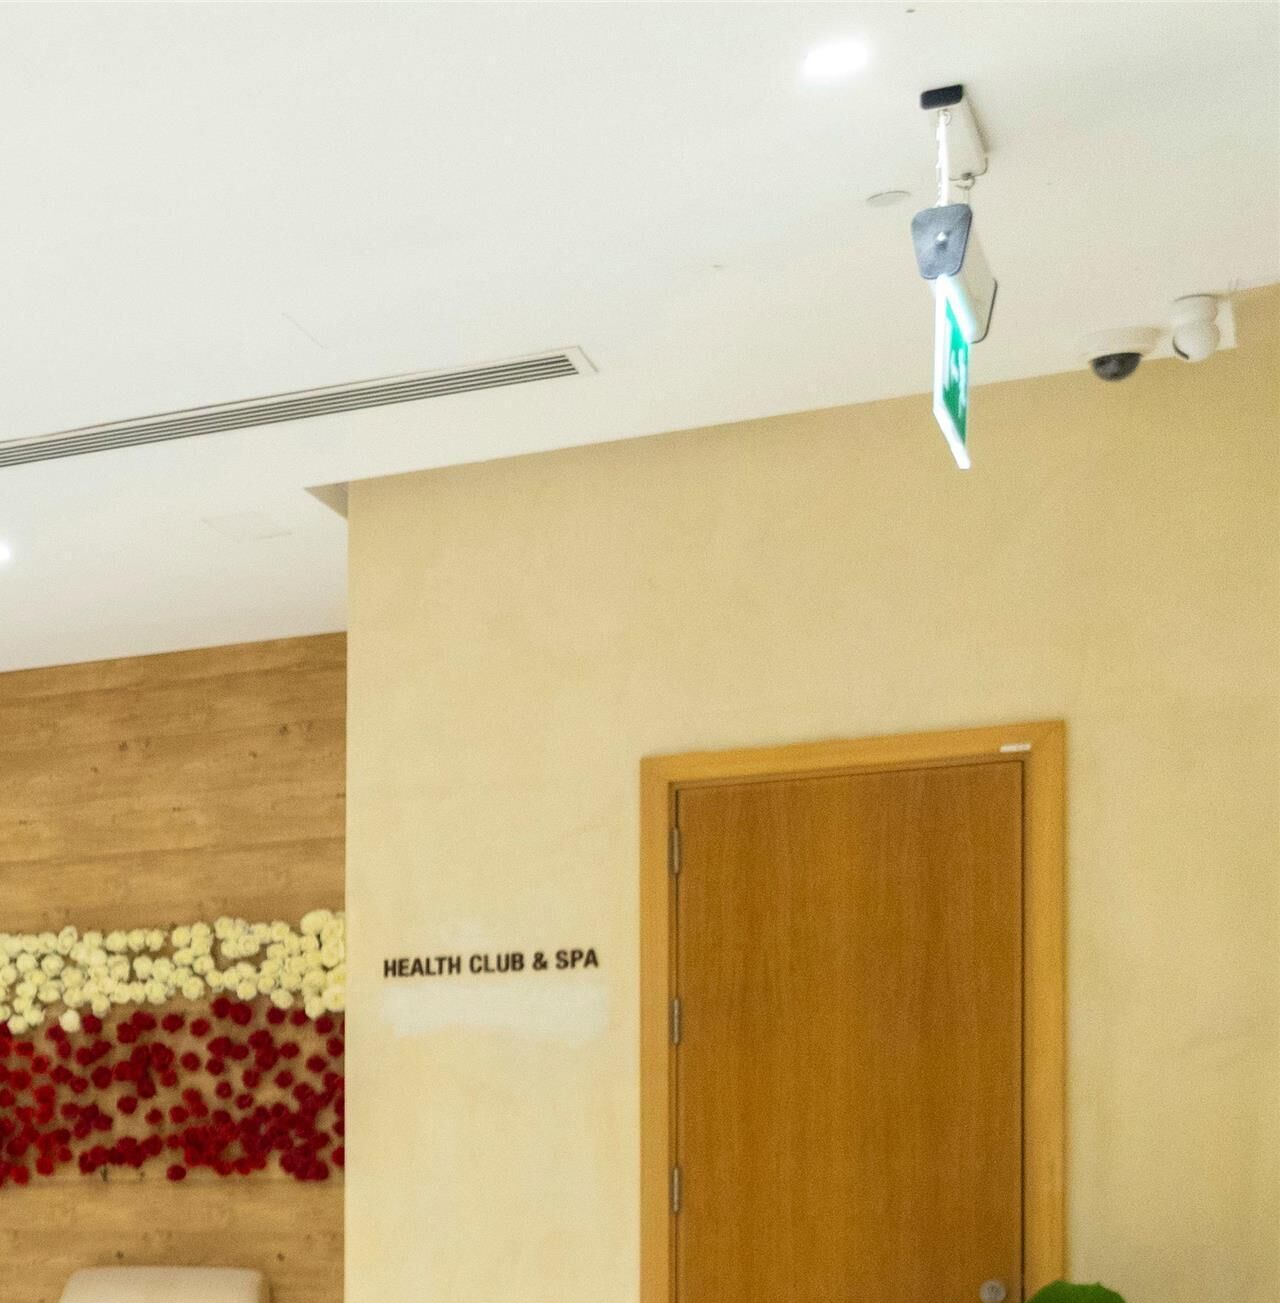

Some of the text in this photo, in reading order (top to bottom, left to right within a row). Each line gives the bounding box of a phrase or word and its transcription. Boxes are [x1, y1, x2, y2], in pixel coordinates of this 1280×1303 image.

[383, 948, 599, 979] HEALTH CLUB & SPA
